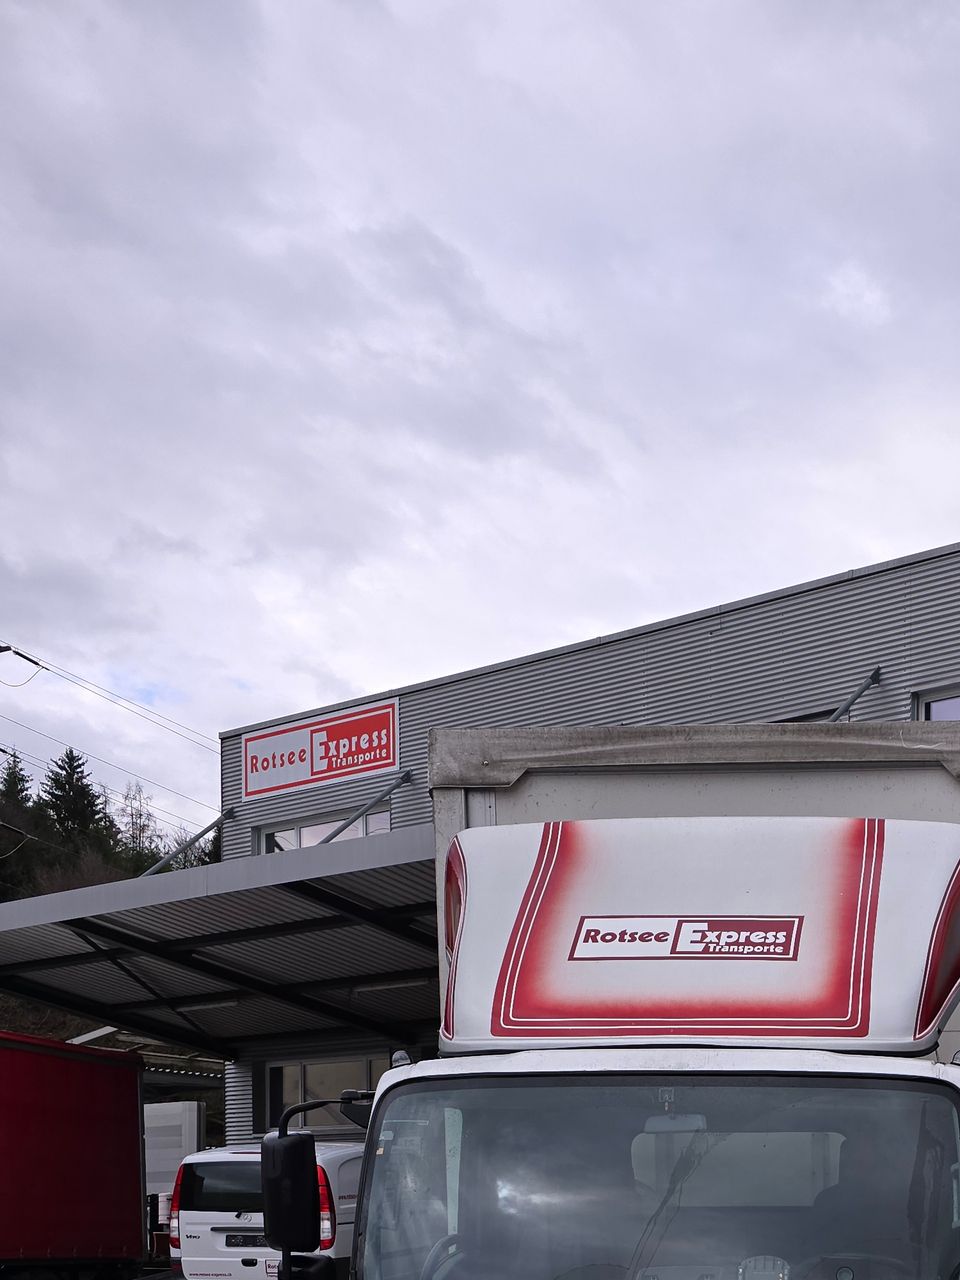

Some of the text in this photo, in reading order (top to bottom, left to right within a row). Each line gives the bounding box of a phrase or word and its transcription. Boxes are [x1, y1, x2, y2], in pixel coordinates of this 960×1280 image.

[250, 728, 388, 774] Rotsee Express
[331, 748, 387, 768] Transporte
[582, 922, 787, 951] Rotsee Express
[708, 943, 784, 954] Transporte
